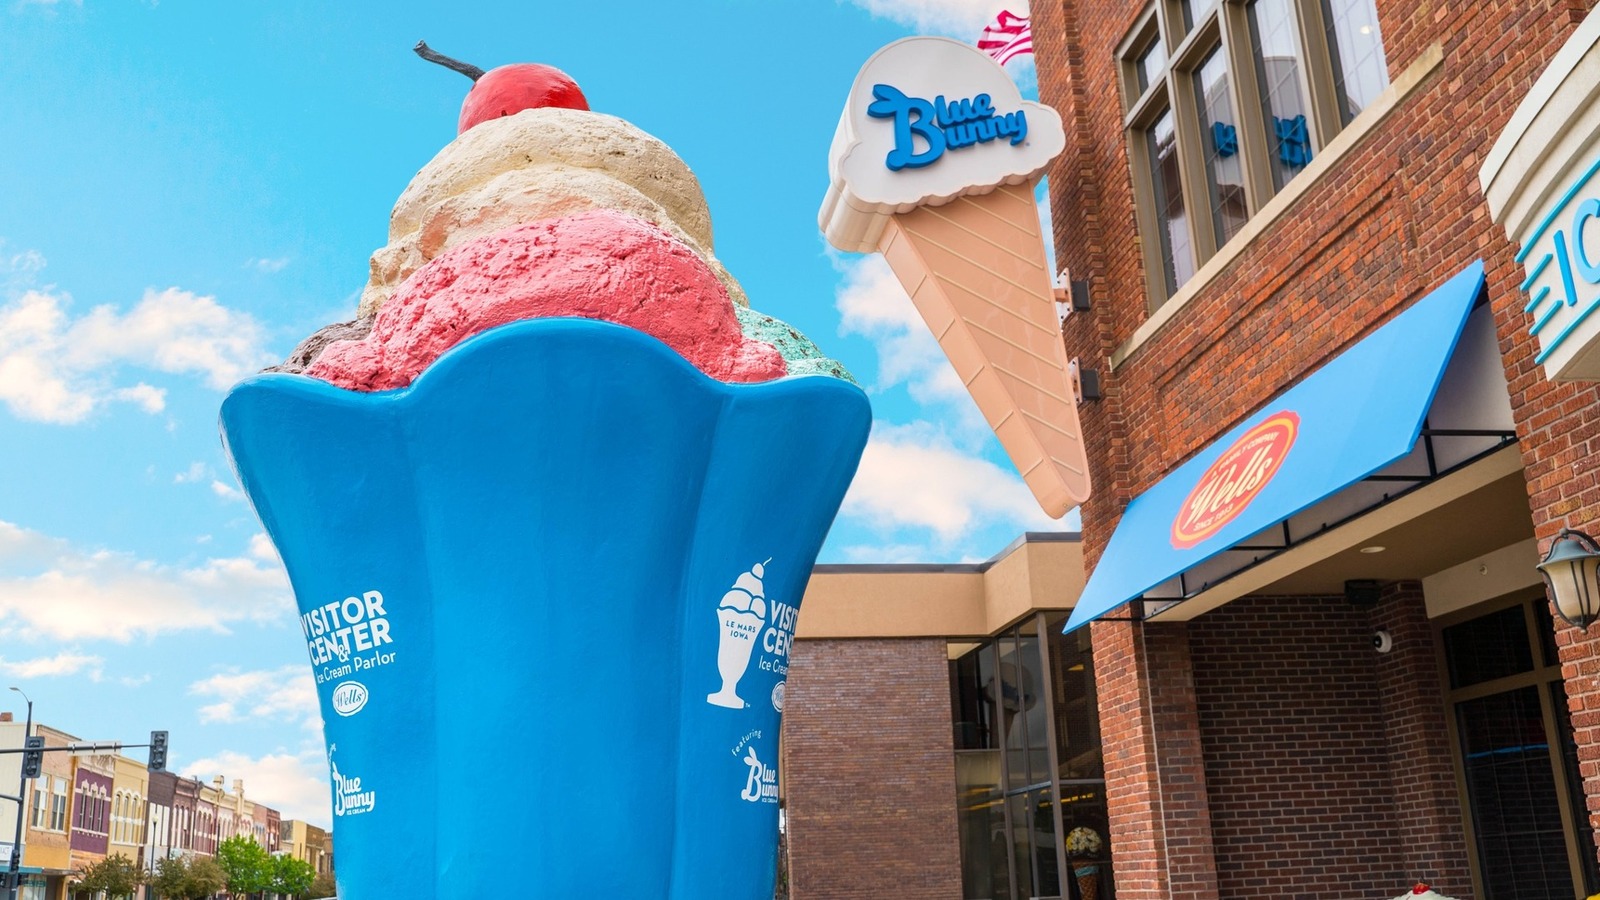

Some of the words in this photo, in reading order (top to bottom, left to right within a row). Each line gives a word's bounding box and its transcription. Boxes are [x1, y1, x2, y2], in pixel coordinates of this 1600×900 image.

[886, 97, 1027, 171] Bunny
[1182, 442, 1274, 530] Wells
[300, 590, 387, 638] VISITOR
[725, 620, 735, 628] LE
[737, 623, 756, 633] MARS
[309, 617, 393, 666] CENTER
[730, 630, 748, 640] IOWA
[324, 664, 352, 681] Cream
[354, 650, 396, 672] Parlor
[338, 644, 349, 663] &
[758, 655, 771, 671] Ice
[731, 729, 762, 757] featuring
[335, 773, 375, 816] Bunny
